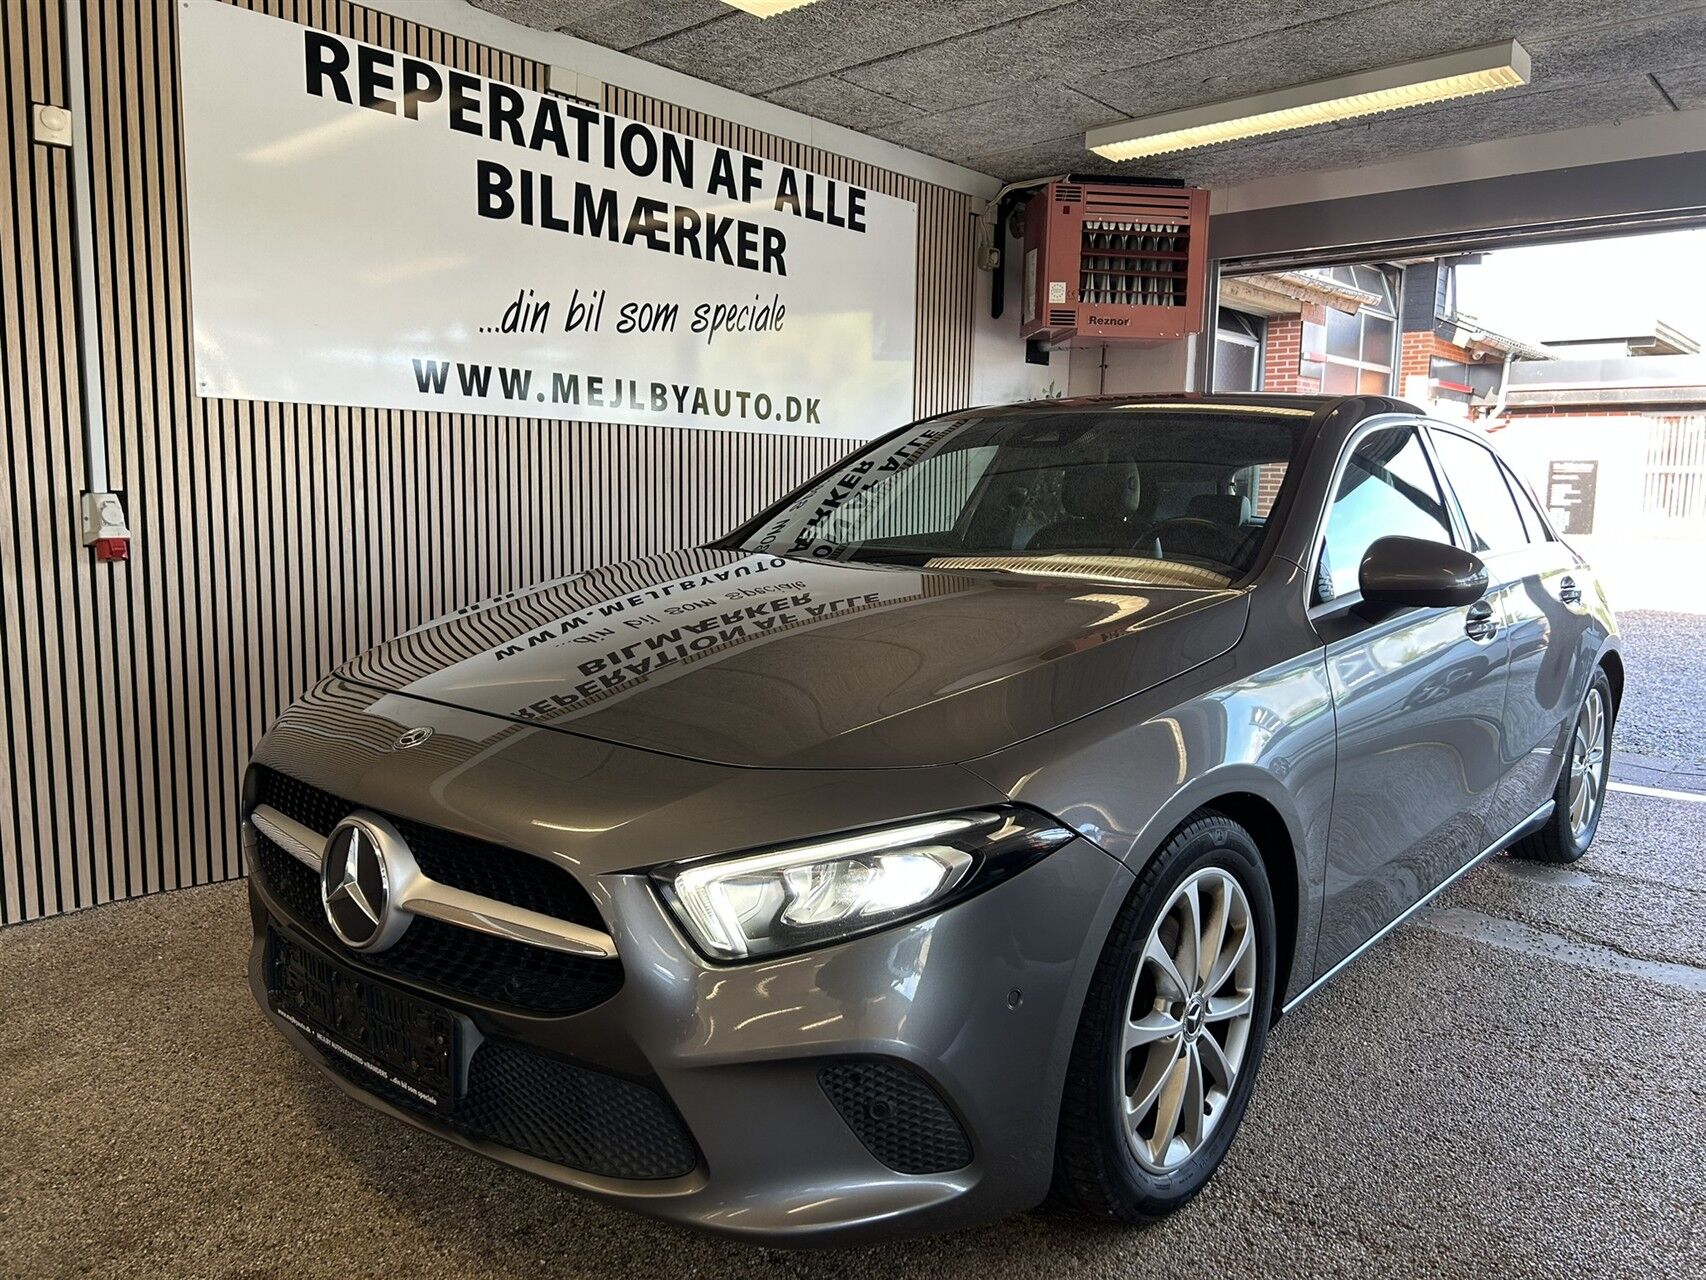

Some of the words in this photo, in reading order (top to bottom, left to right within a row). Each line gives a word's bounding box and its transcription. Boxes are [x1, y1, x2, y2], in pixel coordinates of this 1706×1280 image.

[304, 29, 694, 189] REPERATION
[707, 147, 763, 201] AF
[775, 168, 866, 233] ALLE
[477, 159, 788, 276] BILMÆRKER
[479, 289, 548, 335] ...din
[564, 289, 602, 333] bil
[617, 301, 679, 333] som
[690, 293, 785, 348] speciale
[1088, 315, 1130, 327] Reznor
[412, 358, 822, 425] WWW.MEJLBYAUTO.DK
